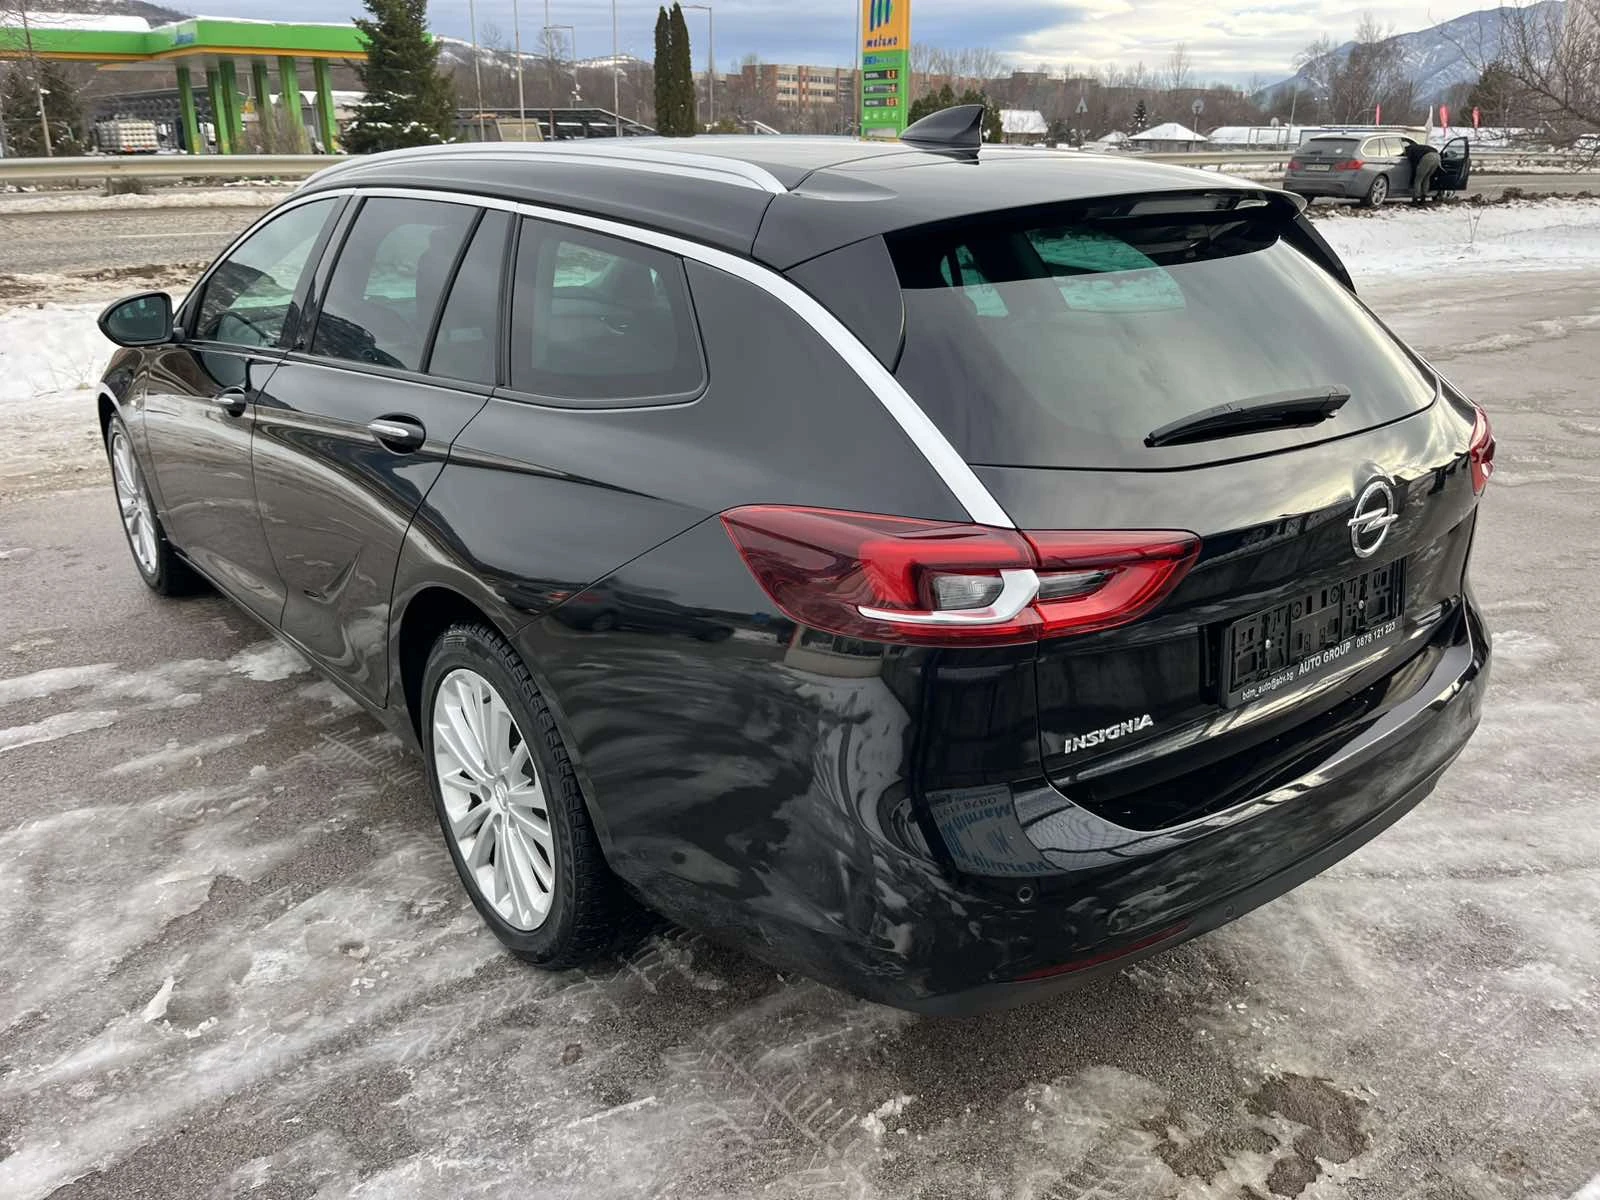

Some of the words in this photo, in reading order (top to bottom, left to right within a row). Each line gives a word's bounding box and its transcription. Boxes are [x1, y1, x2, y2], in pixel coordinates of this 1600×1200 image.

[1298, 655, 1321, 676] AUTO
[1323, 641, 1351, 663] GROUP
[1373, 627, 1384, 640] 121
[1385, 621, 1396, 634] 223
[1064, 714, 1154, 754] INSIGNIA
